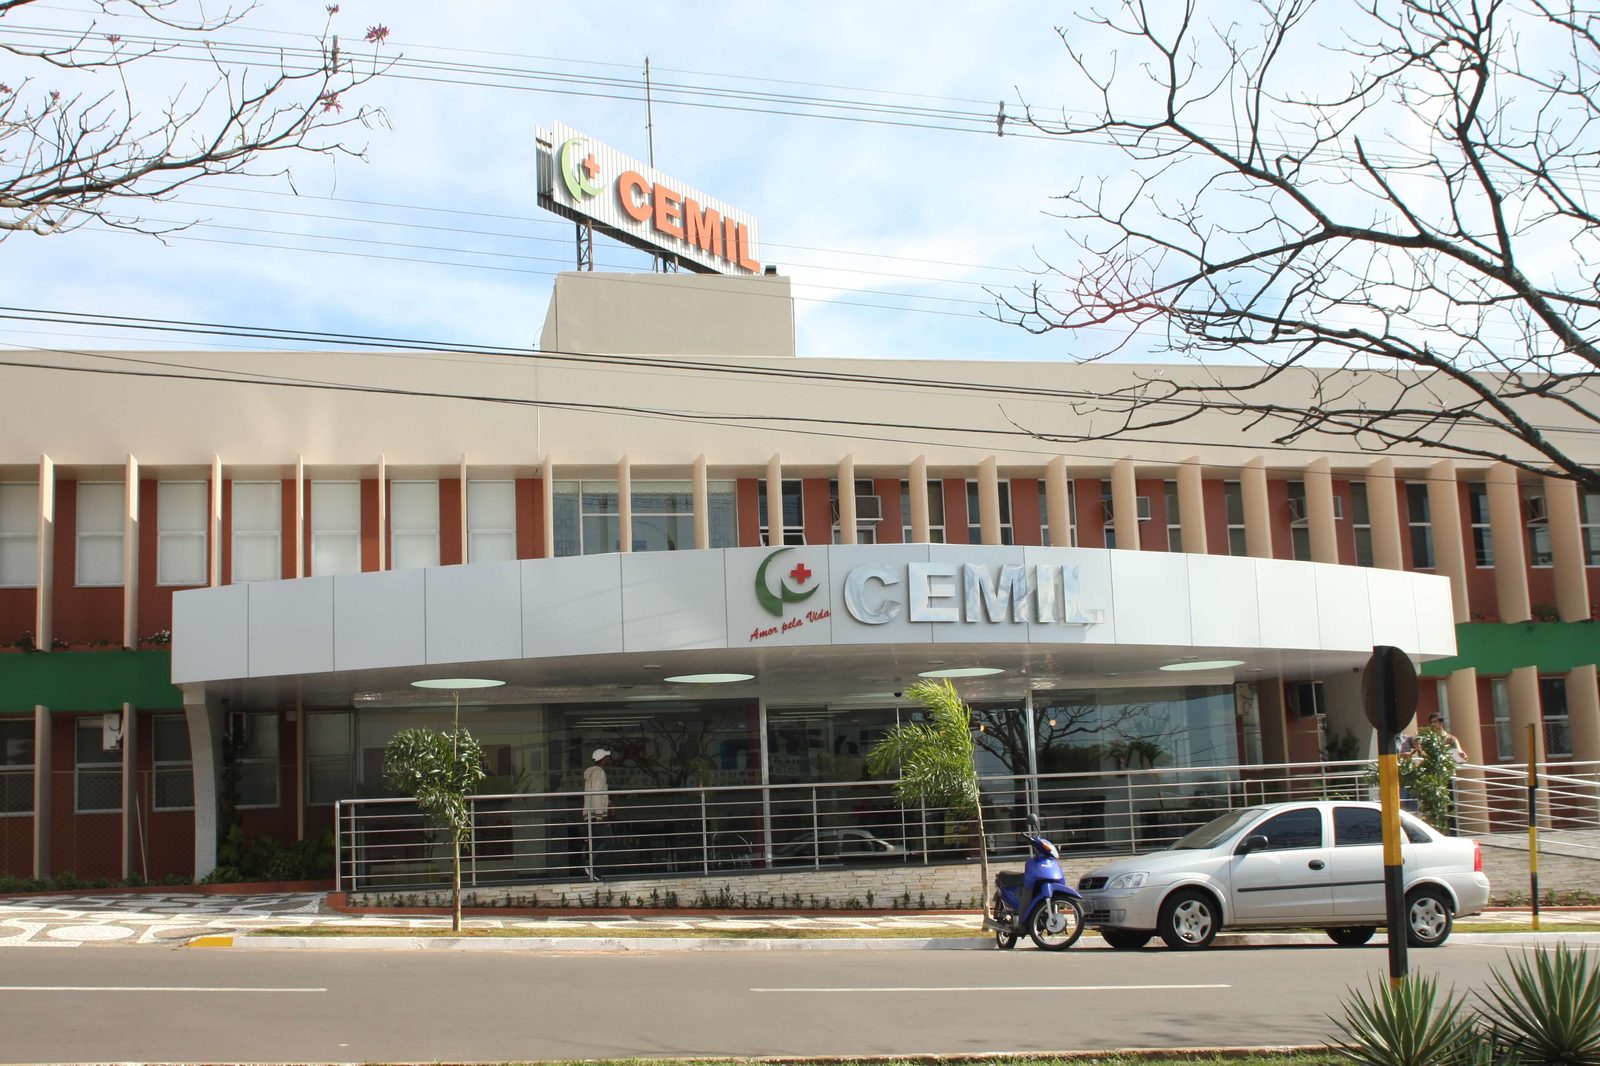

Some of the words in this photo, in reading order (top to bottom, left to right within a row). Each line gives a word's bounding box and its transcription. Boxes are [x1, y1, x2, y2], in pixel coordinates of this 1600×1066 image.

[617, 170, 761, 273] CEMIL
[749, 627, 778, 642] Amor
[781, 617, 803, 634] pela
[806, 608, 831, 622] Vida
[843, 561, 1105, 625] CEMIL
